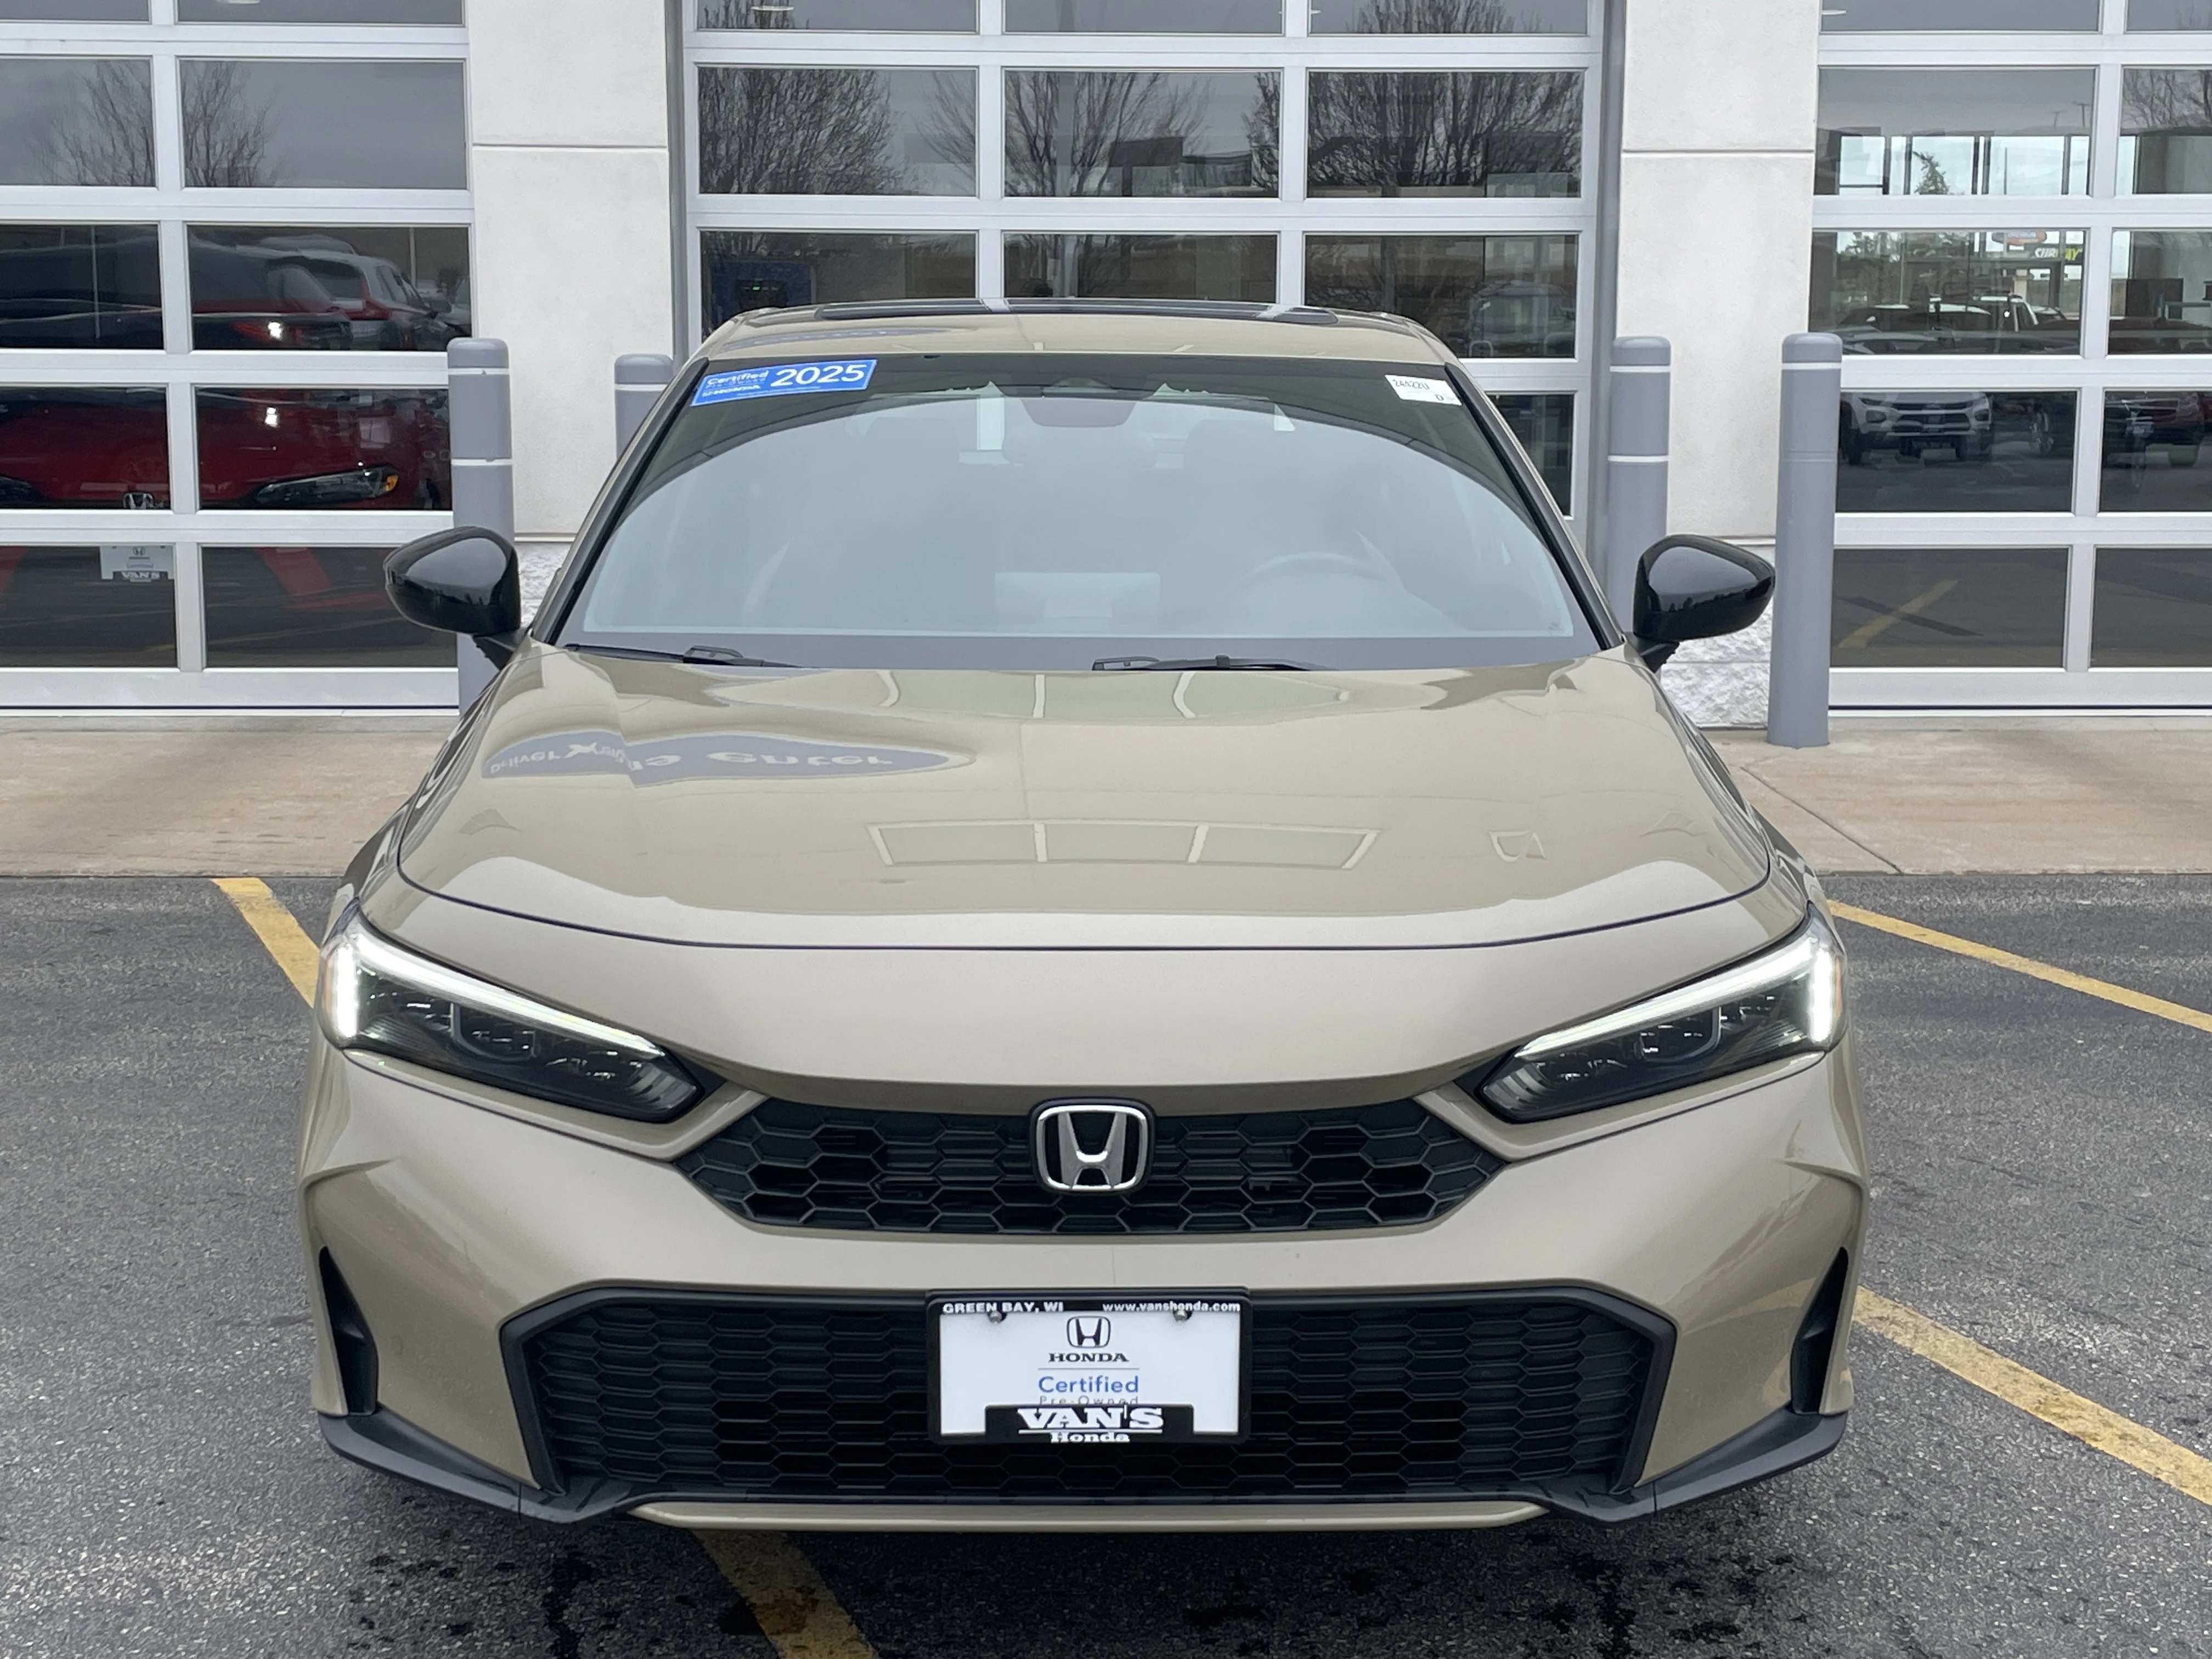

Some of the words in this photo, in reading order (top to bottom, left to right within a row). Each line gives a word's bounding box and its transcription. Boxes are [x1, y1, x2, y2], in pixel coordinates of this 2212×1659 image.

[771, 364, 868, 387] 2025
[943, 1302, 997, 1314] GREEN
[1002, 1301, 1040, 1314] BAY,
[1043, 1301, 1064, 1313] WI
[1102, 1301, 1241, 1312] www.vanshonda.com
[1048, 1352, 1129, 1363] HONDA
[1039, 1375, 1139, 1393] Certified
[1050, 1431, 1131, 1443] Honda
